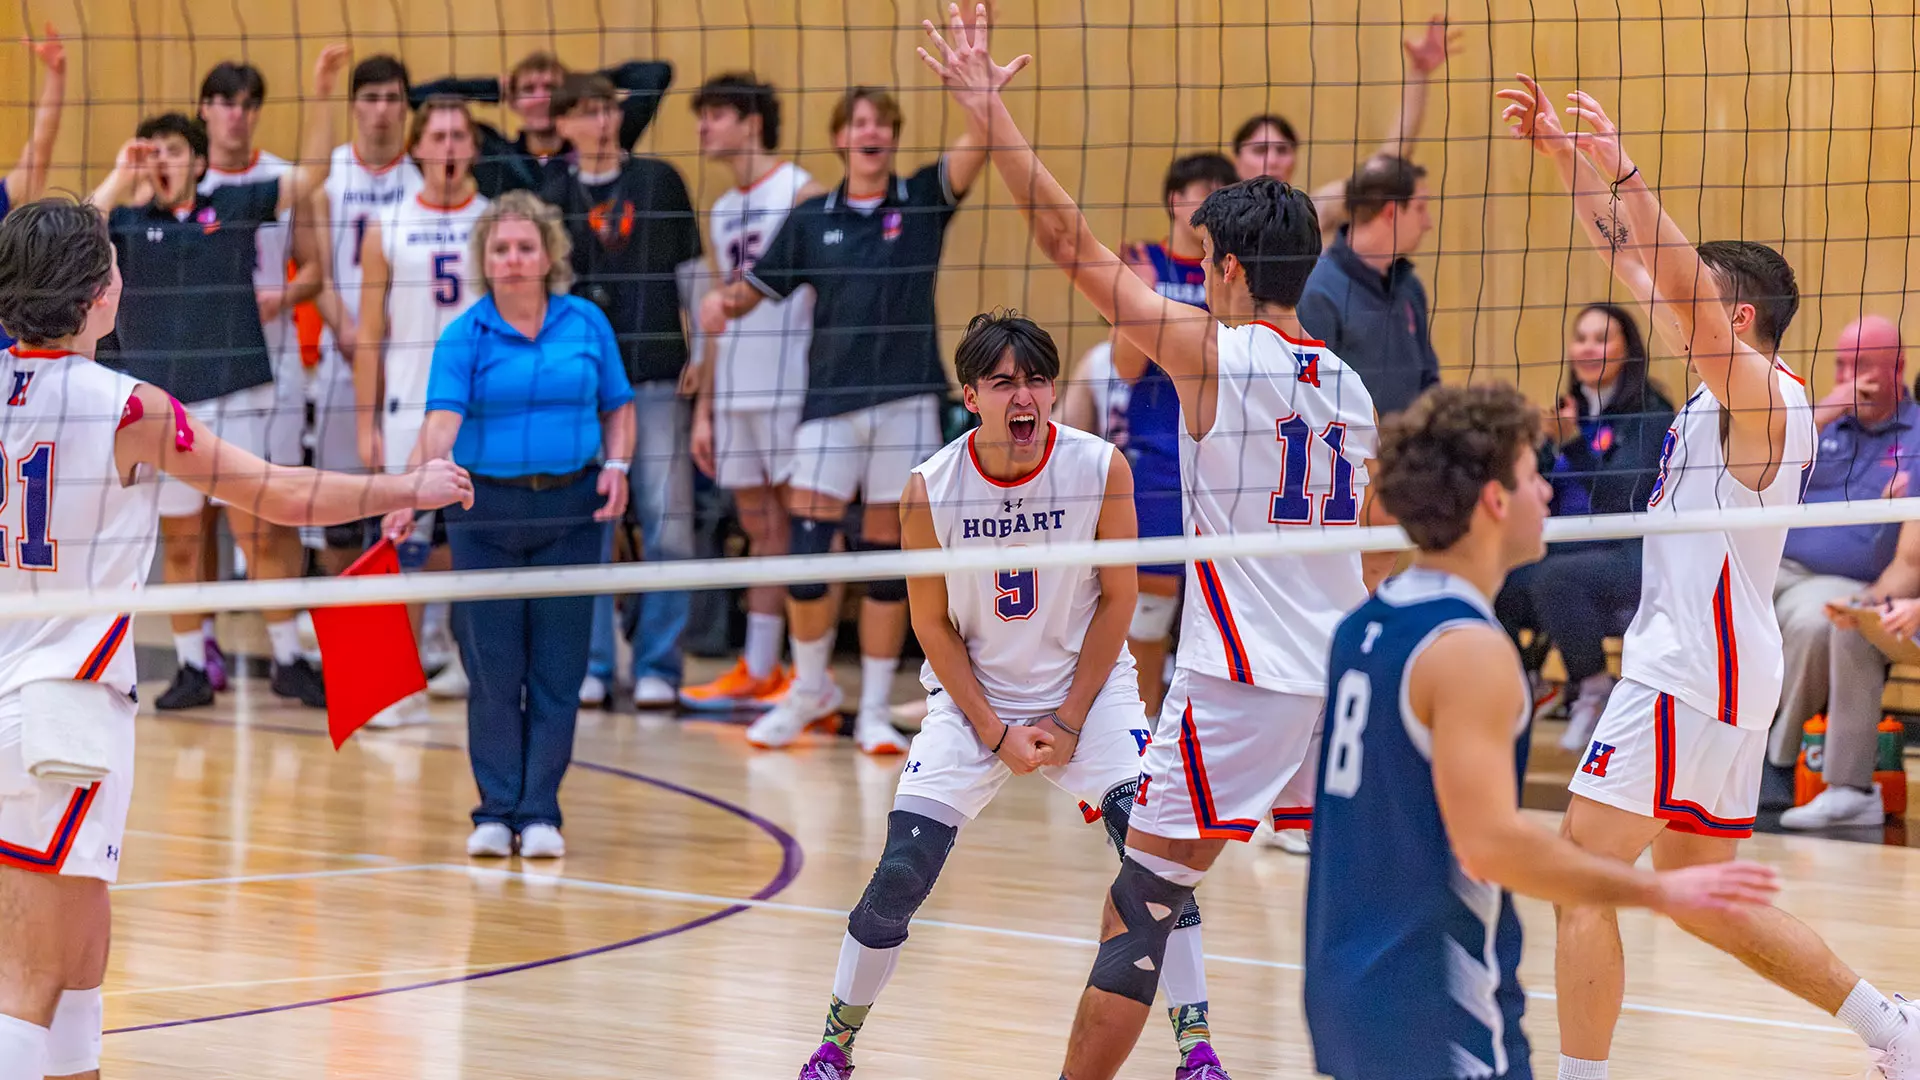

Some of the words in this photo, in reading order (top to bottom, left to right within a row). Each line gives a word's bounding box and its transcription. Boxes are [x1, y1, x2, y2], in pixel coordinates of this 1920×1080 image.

[432, 251, 461, 306] 5
[7, 370, 35, 406] H
[1292, 352, 1321, 388] H
[1268, 411, 1358, 526] 11
[0, 440, 57, 572] 1
[963, 509, 1065, 539] HOBART
[1360, 620, 1383, 654] T
[1324, 668, 1372, 799] 8
[1581, 740, 1616, 778] H
